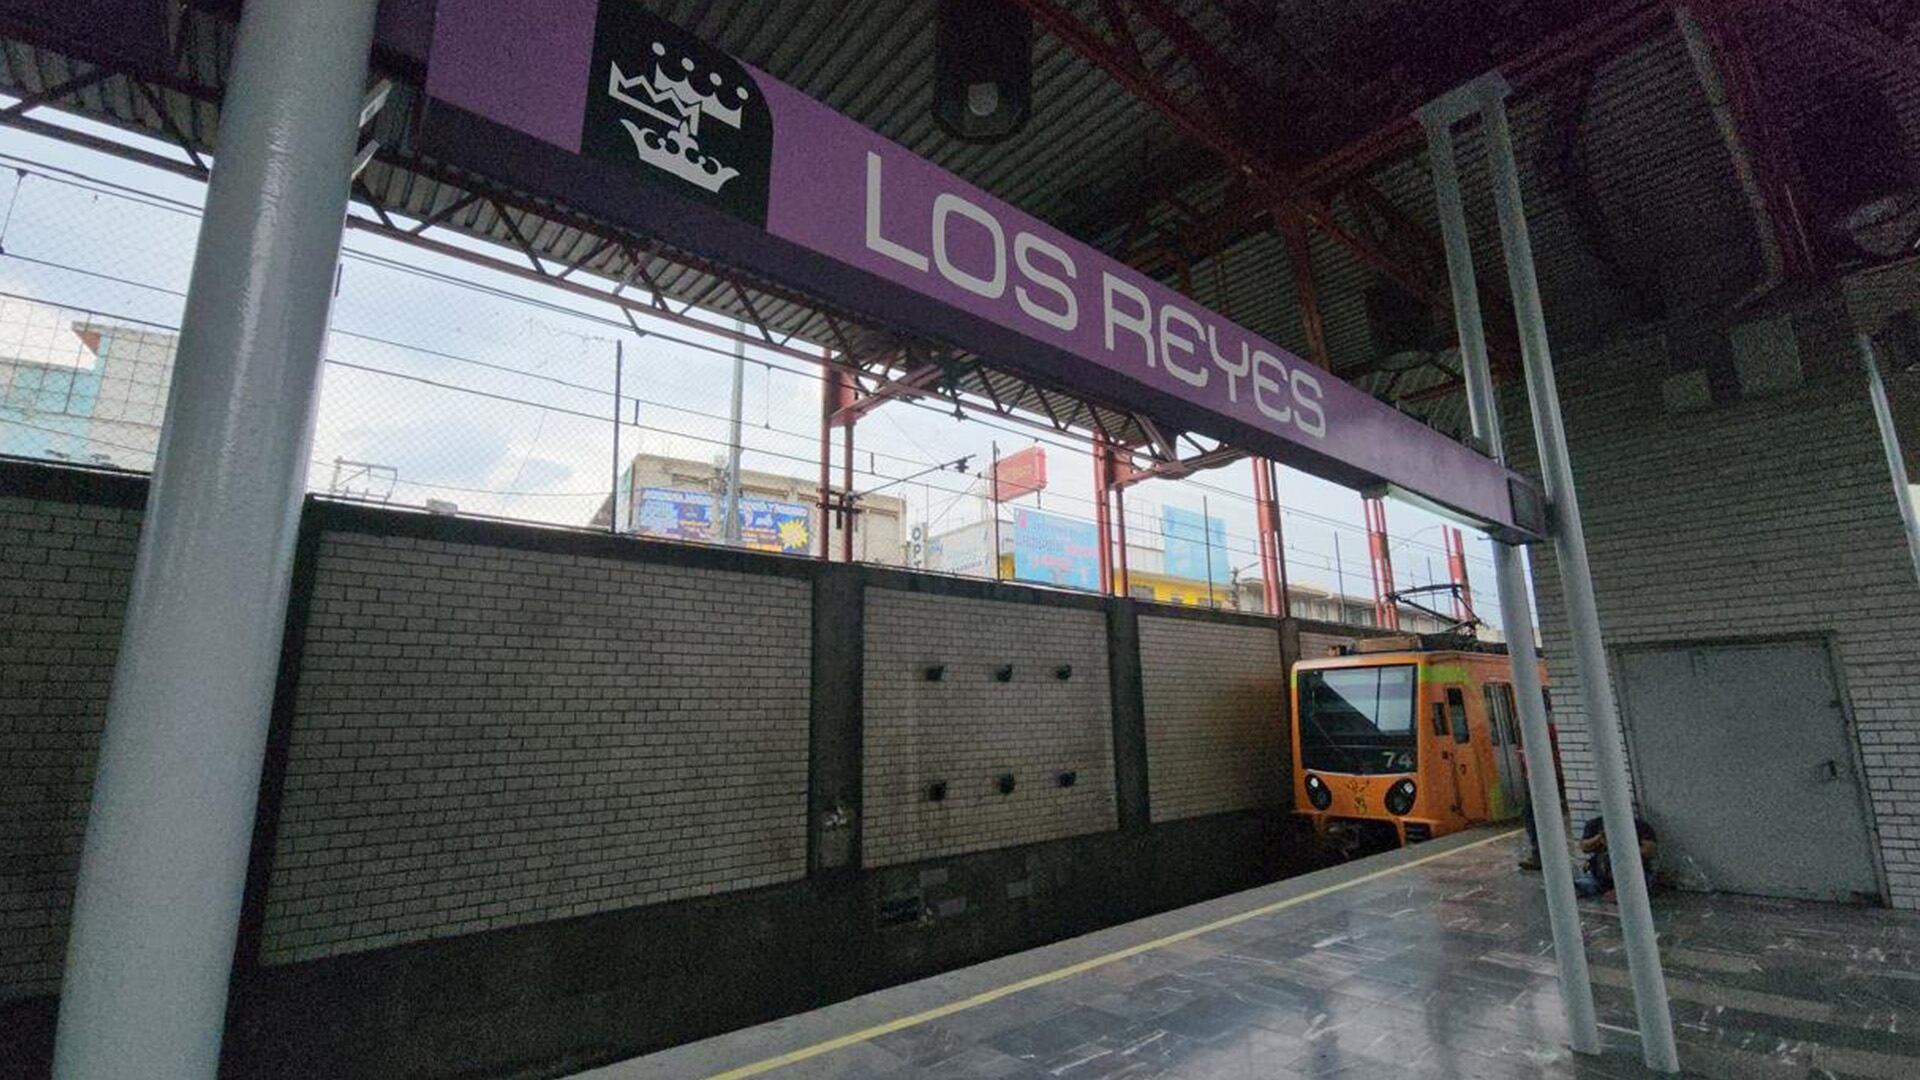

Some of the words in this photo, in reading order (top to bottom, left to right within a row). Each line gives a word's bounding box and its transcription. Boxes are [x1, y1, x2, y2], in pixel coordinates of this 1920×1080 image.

[865, 151, 1078, 332] LOS
[1103, 270, 1328, 440] REYES
[1382, 751, 1413, 769] 74
